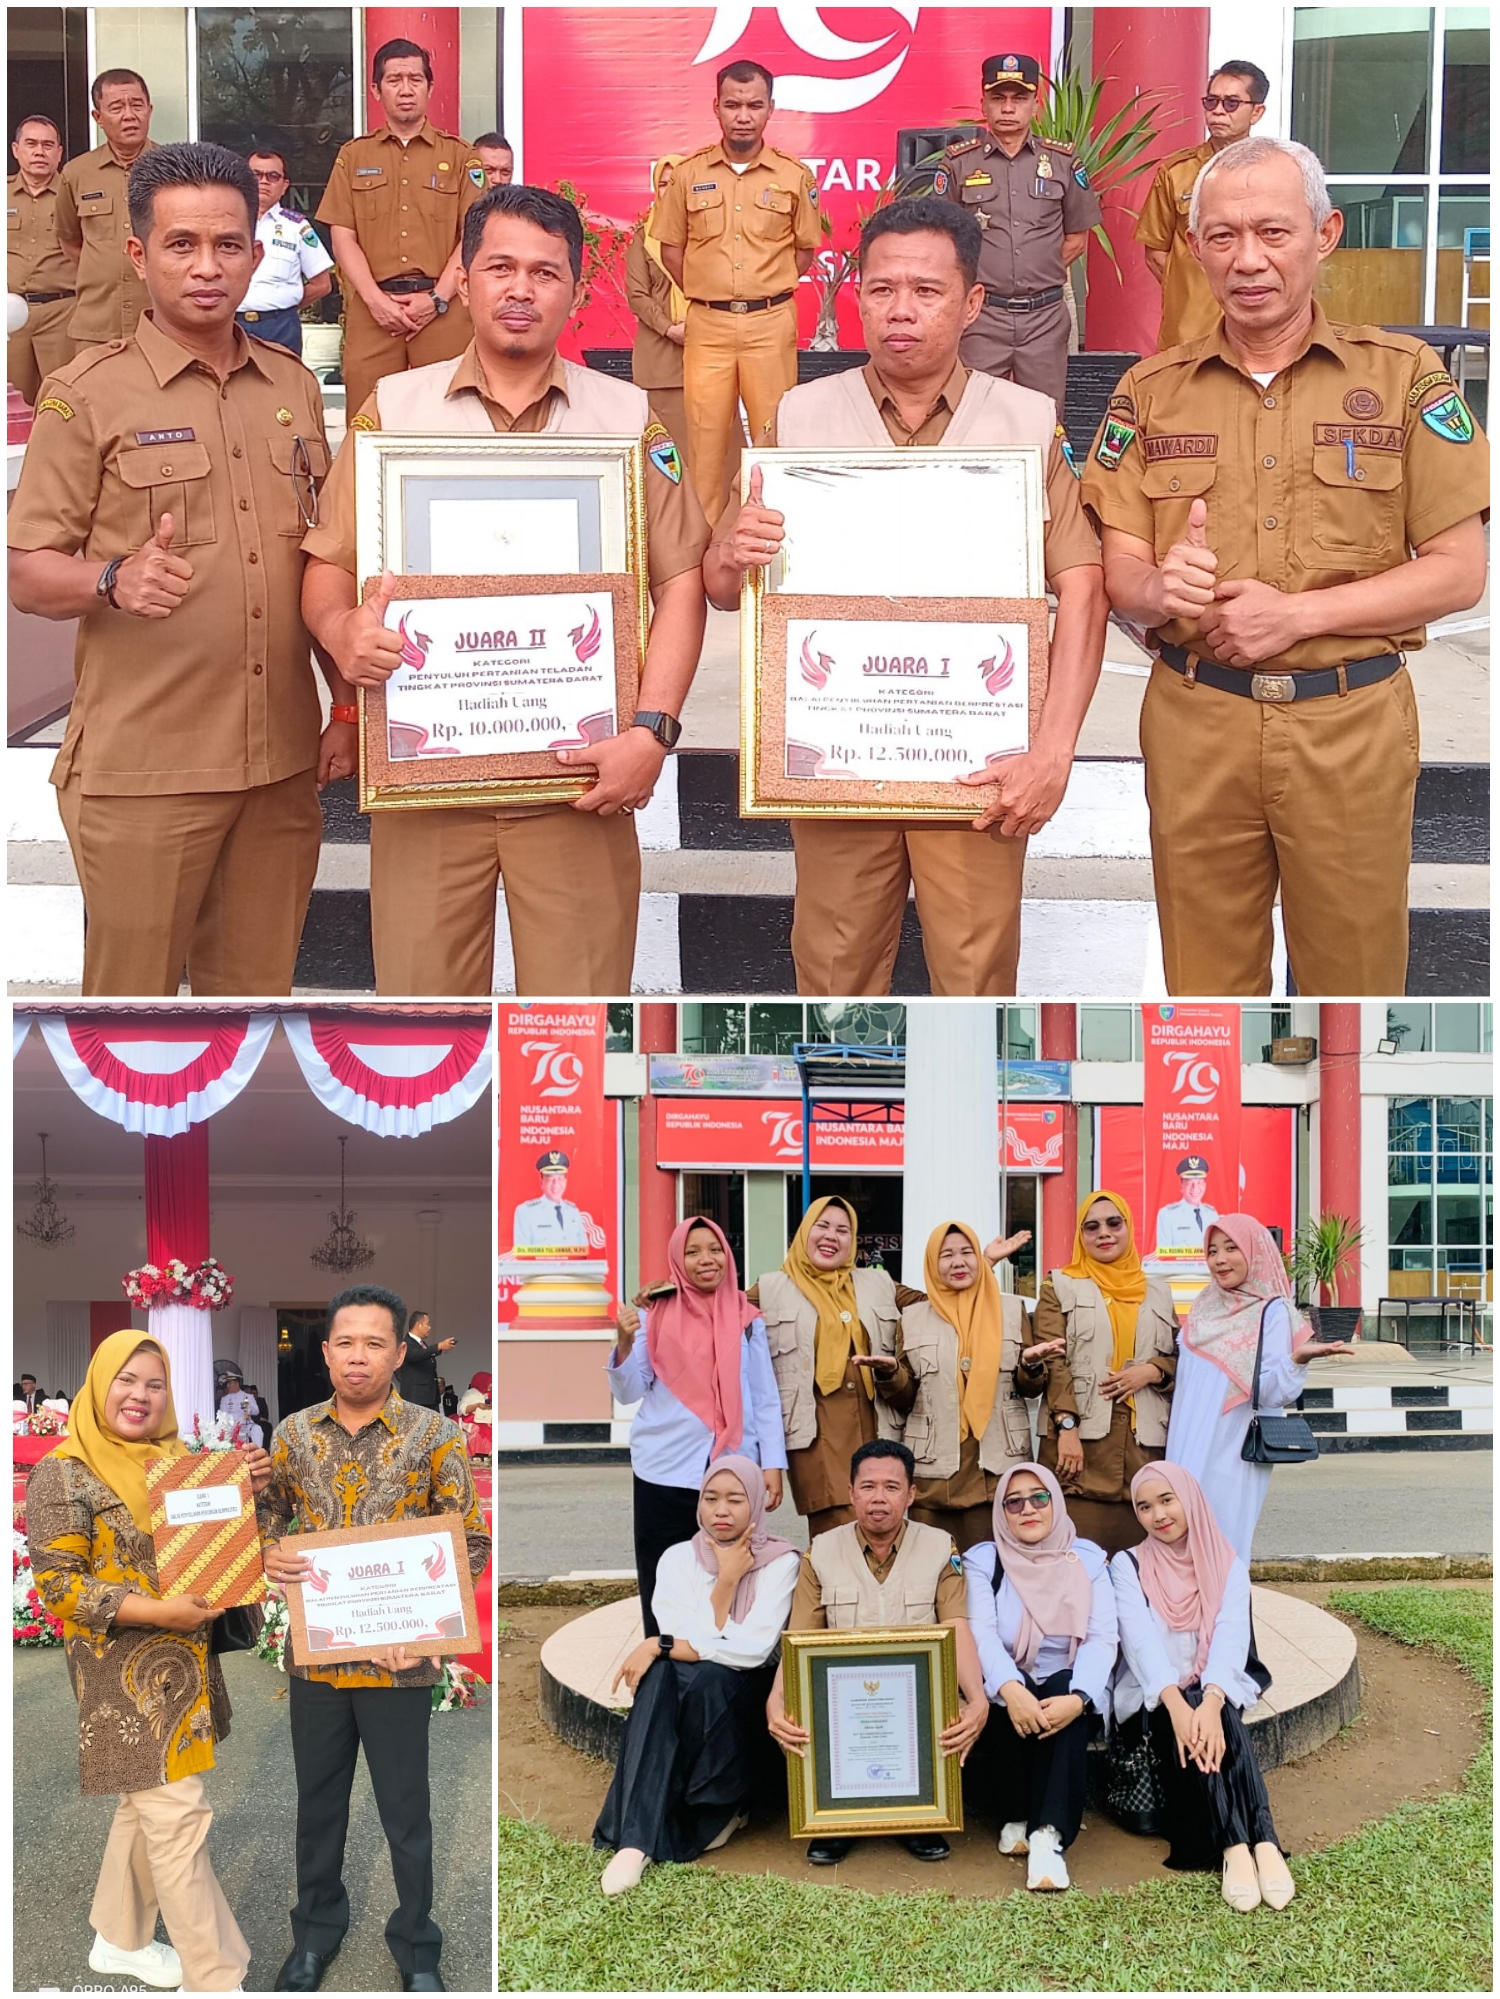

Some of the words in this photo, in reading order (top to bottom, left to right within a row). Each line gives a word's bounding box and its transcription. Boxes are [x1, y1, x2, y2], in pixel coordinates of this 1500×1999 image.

[149, 432, 183, 441] ANTO
[1323, 428, 1398, 447] SEKDA
[455, 630, 518, 649] JUARA
[529, 629, 546, 646] II
[473, 658, 530, 667] KATEGORI
[863, 656, 929, 674] JUARA
[940, 658, 950, 675] I
[409, 671, 470, 681] PENYULUH
[472, 668, 539, 678] PERTANIAN
[541, 666, 593, 674] TELADAN
[398, 683, 448, 691] TINGKAT
[450, 680, 502, 688] PROVINSI
[504, 677, 564, 686] SUMATERA
[566, 675, 603, 683] BARAT
[459, 697, 508, 711] Hadiah
[433, 723, 463, 742] Rp.
[831, 745, 861, 764] Rp.
[508, 1013, 597, 1027] DIRGAHAYU
[508, 1027, 548, 1035] REPUBLIK
[550, 1028, 596, 1036] INDONESIA
[1151, 1025, 1231, 1037] DIRGAHAYU
[521, 1041, 583, 1097] 79
[1163, 1051, 1220, 1104] 79
[520, 1105, 582, 1114] NUSANTARA
[520, 1115, 549, 1123] BARU
[1162, 1112, 1219, 1121] NUSANTARA
[520, 1126, 575, 1135] INDONESIA
[816, 1122, 884, 1133] NUSANTARA
[1162, 1121, 1188, 1130] BARU
[520, 1136, 551, 1144] MAJU
[816, 1136, 876, 1146] INDONESIA
[1162, 1132, 1213, 1141] INDONESIA
[1162, 1142, 1189, 1150] MAJU
[348, 1563, 391, 1578] JUARA
[397, 1561, 404, 1573] I
[351, 1607, 385, 1618] Hadiah
[387, 1605, 413, 1614] Uang
[335, 1626, 356, 1638] Rp.
